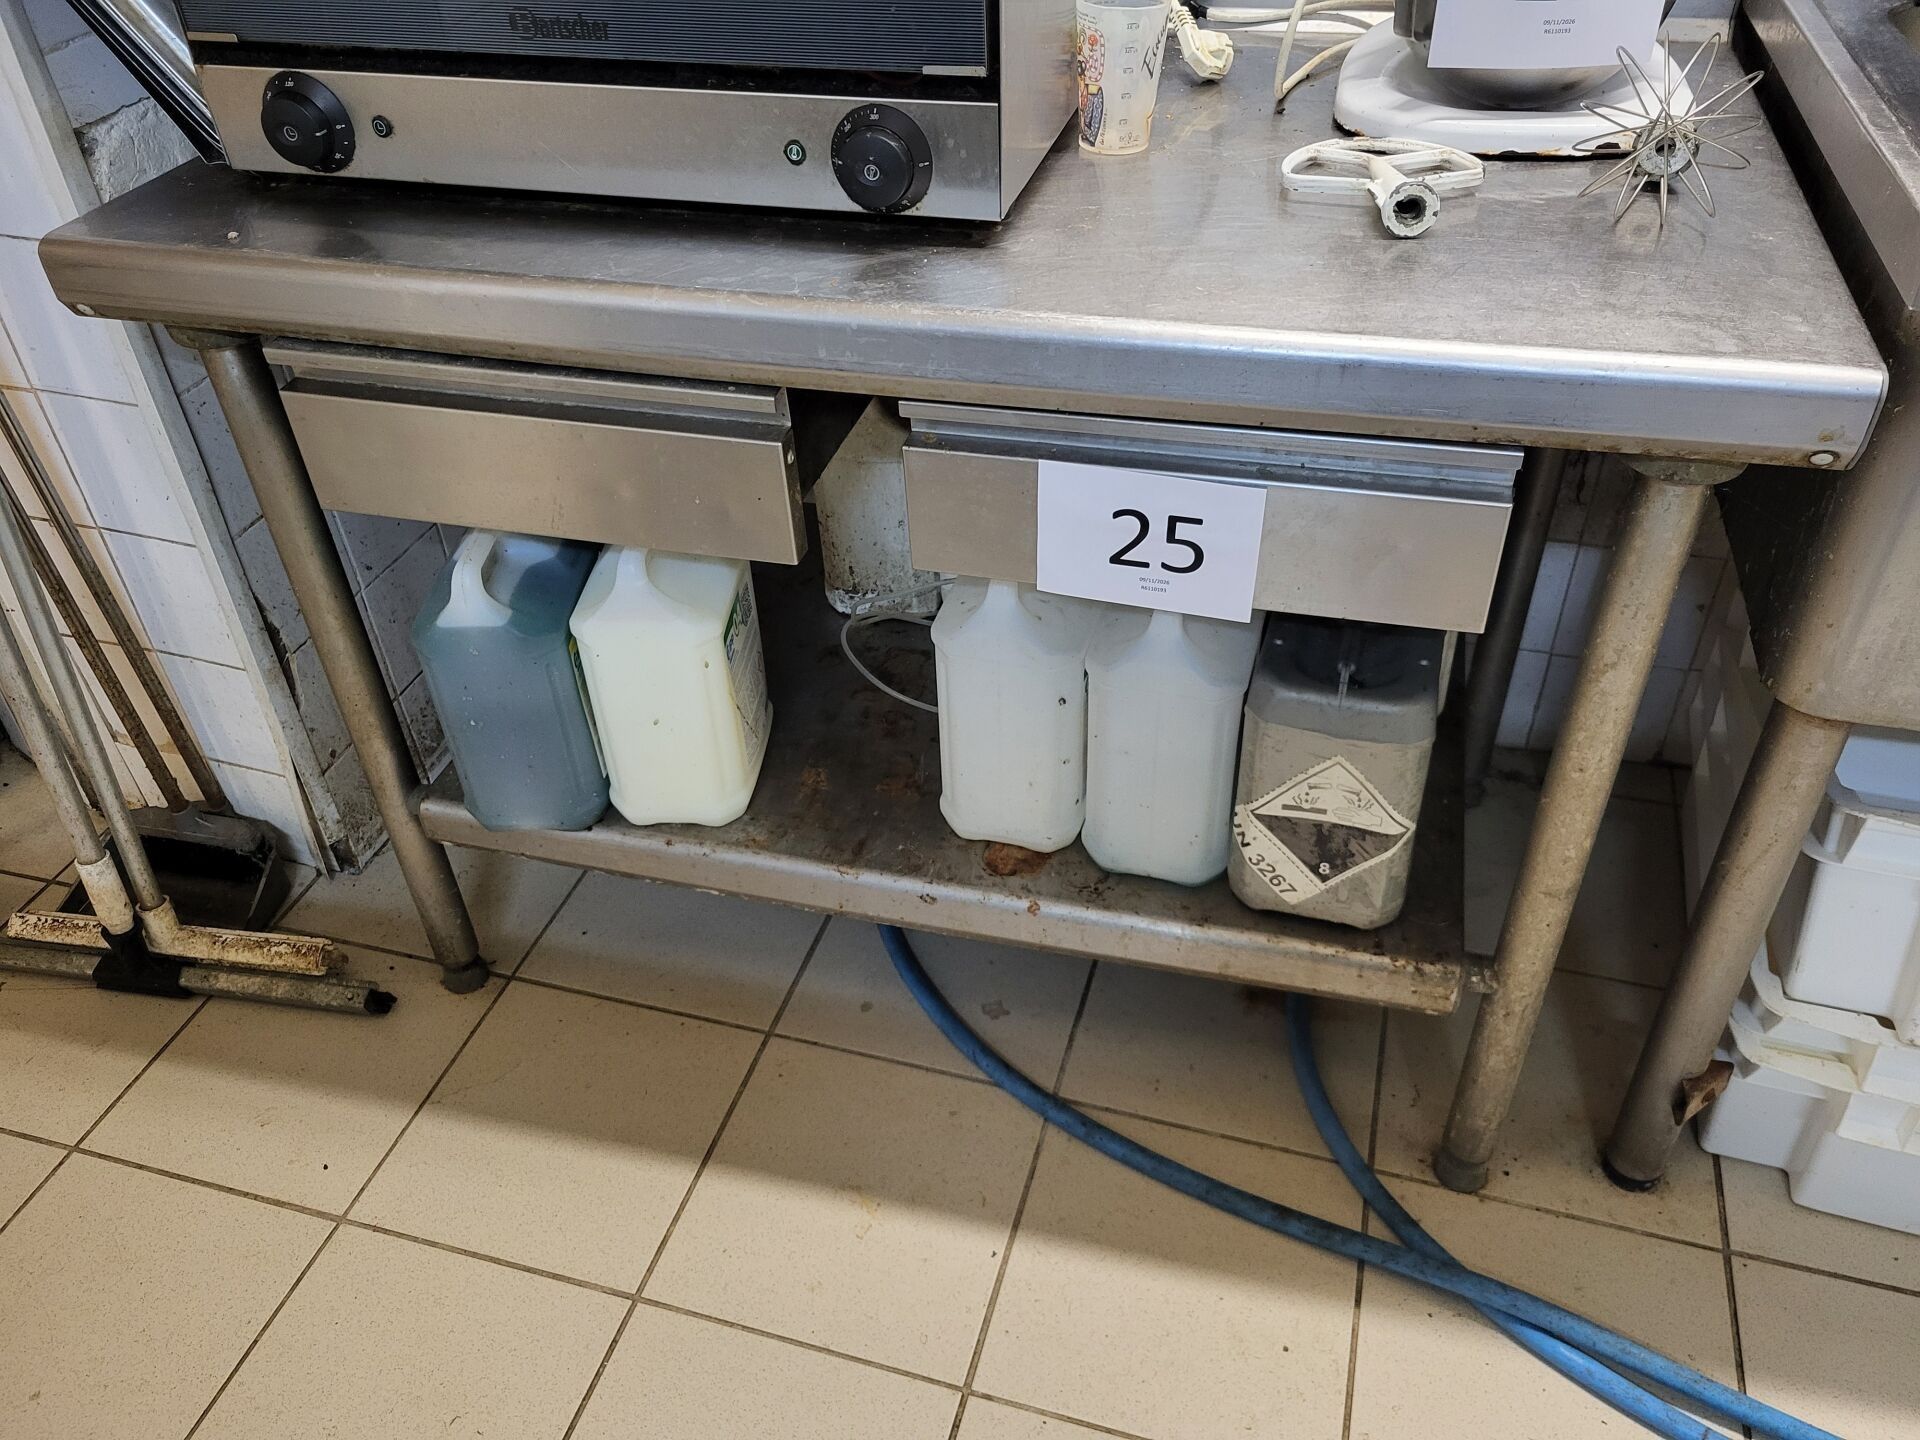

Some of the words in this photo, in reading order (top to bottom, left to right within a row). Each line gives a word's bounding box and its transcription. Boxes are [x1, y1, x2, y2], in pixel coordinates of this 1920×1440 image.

[1109, 508, 1205, 574] 25
[1139, 577, 1170, 585] 09/11/2026
[1141, 585, 1167, 593] R6110193
[1248, 853, 1298, 894] 3267
[1318, 862, 1330, 875] 8
